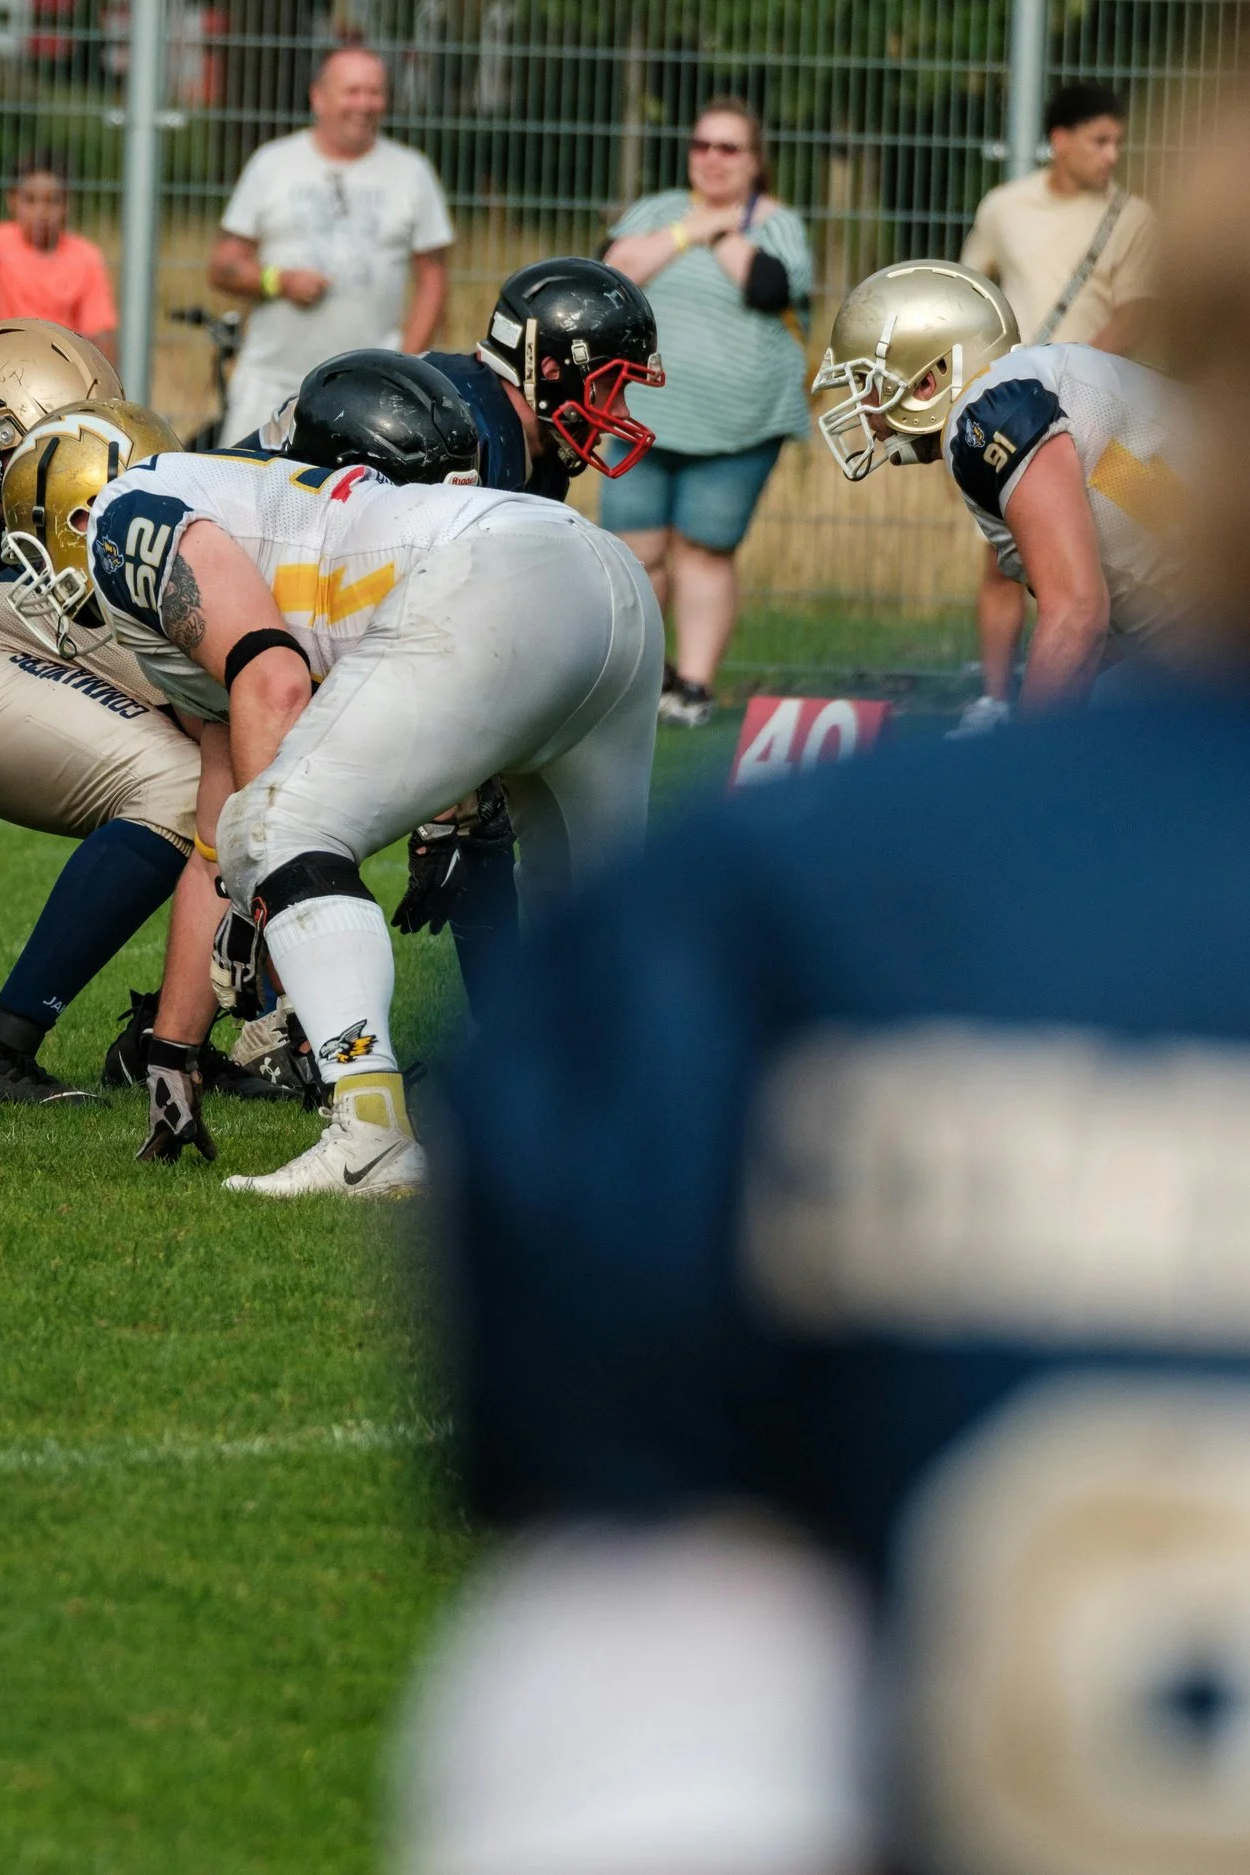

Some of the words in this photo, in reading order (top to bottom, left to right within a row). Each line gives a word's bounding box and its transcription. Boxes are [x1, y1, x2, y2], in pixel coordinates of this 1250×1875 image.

[983, 431, 1017, 474] 91
[125, 517, 171, 612] 52
[733, 698, 858, 786] 40
